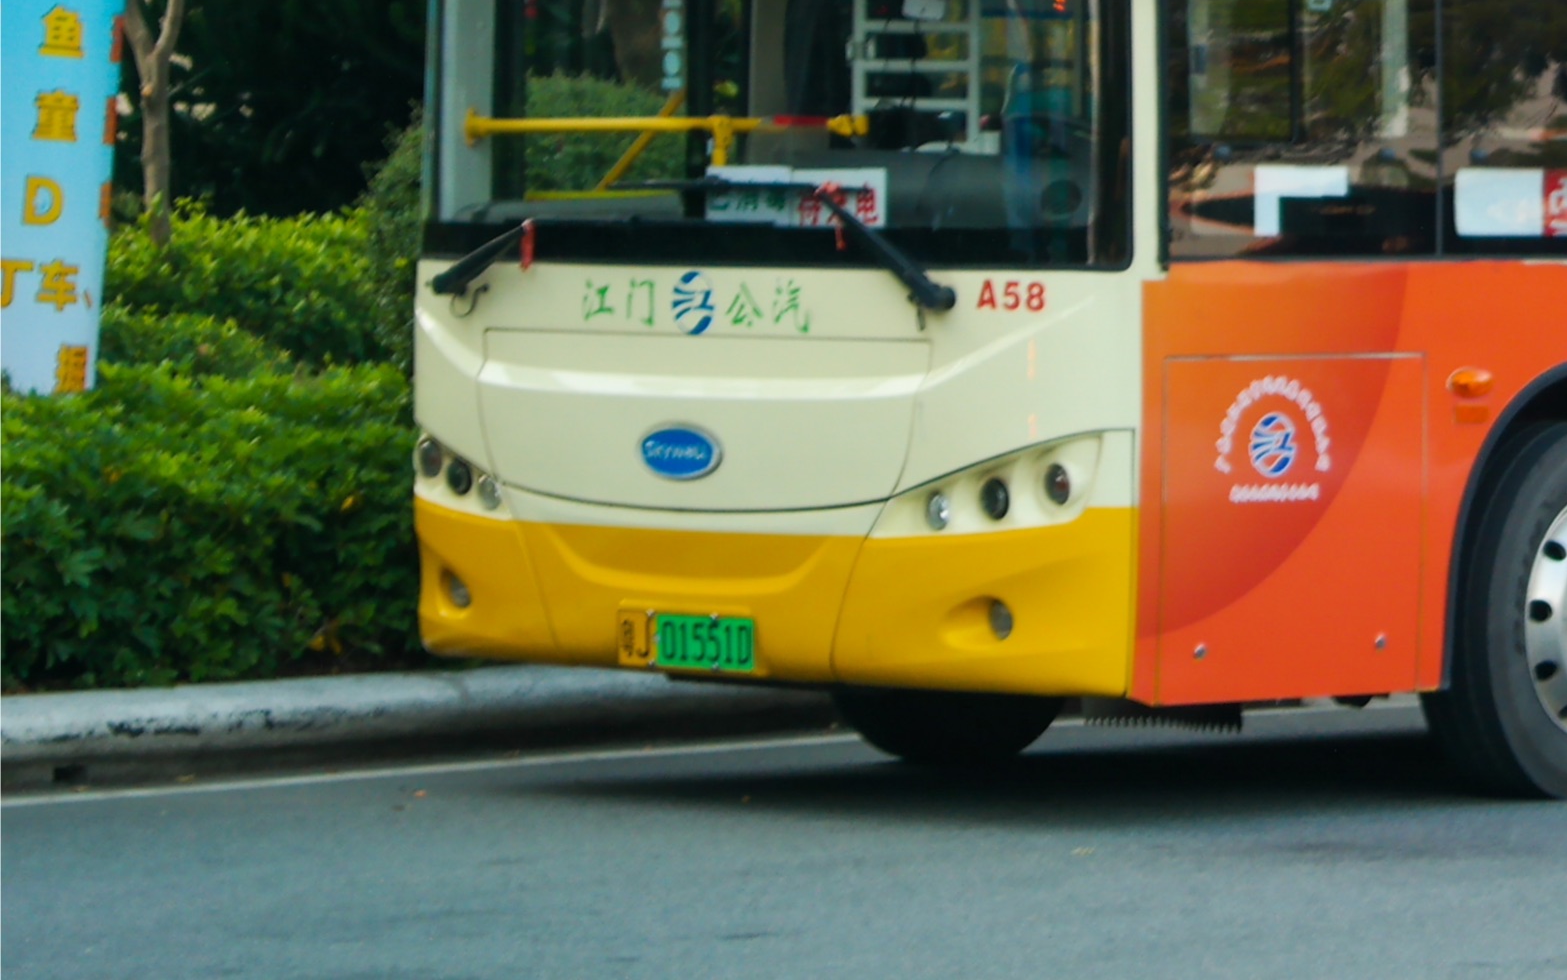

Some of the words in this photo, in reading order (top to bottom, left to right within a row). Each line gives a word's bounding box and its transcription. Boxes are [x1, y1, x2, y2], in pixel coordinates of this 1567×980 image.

[580, 277, 659, 329] 江门
[723, 278, 813, 335] 公汽
[976, 279, 1047, 313] A58
